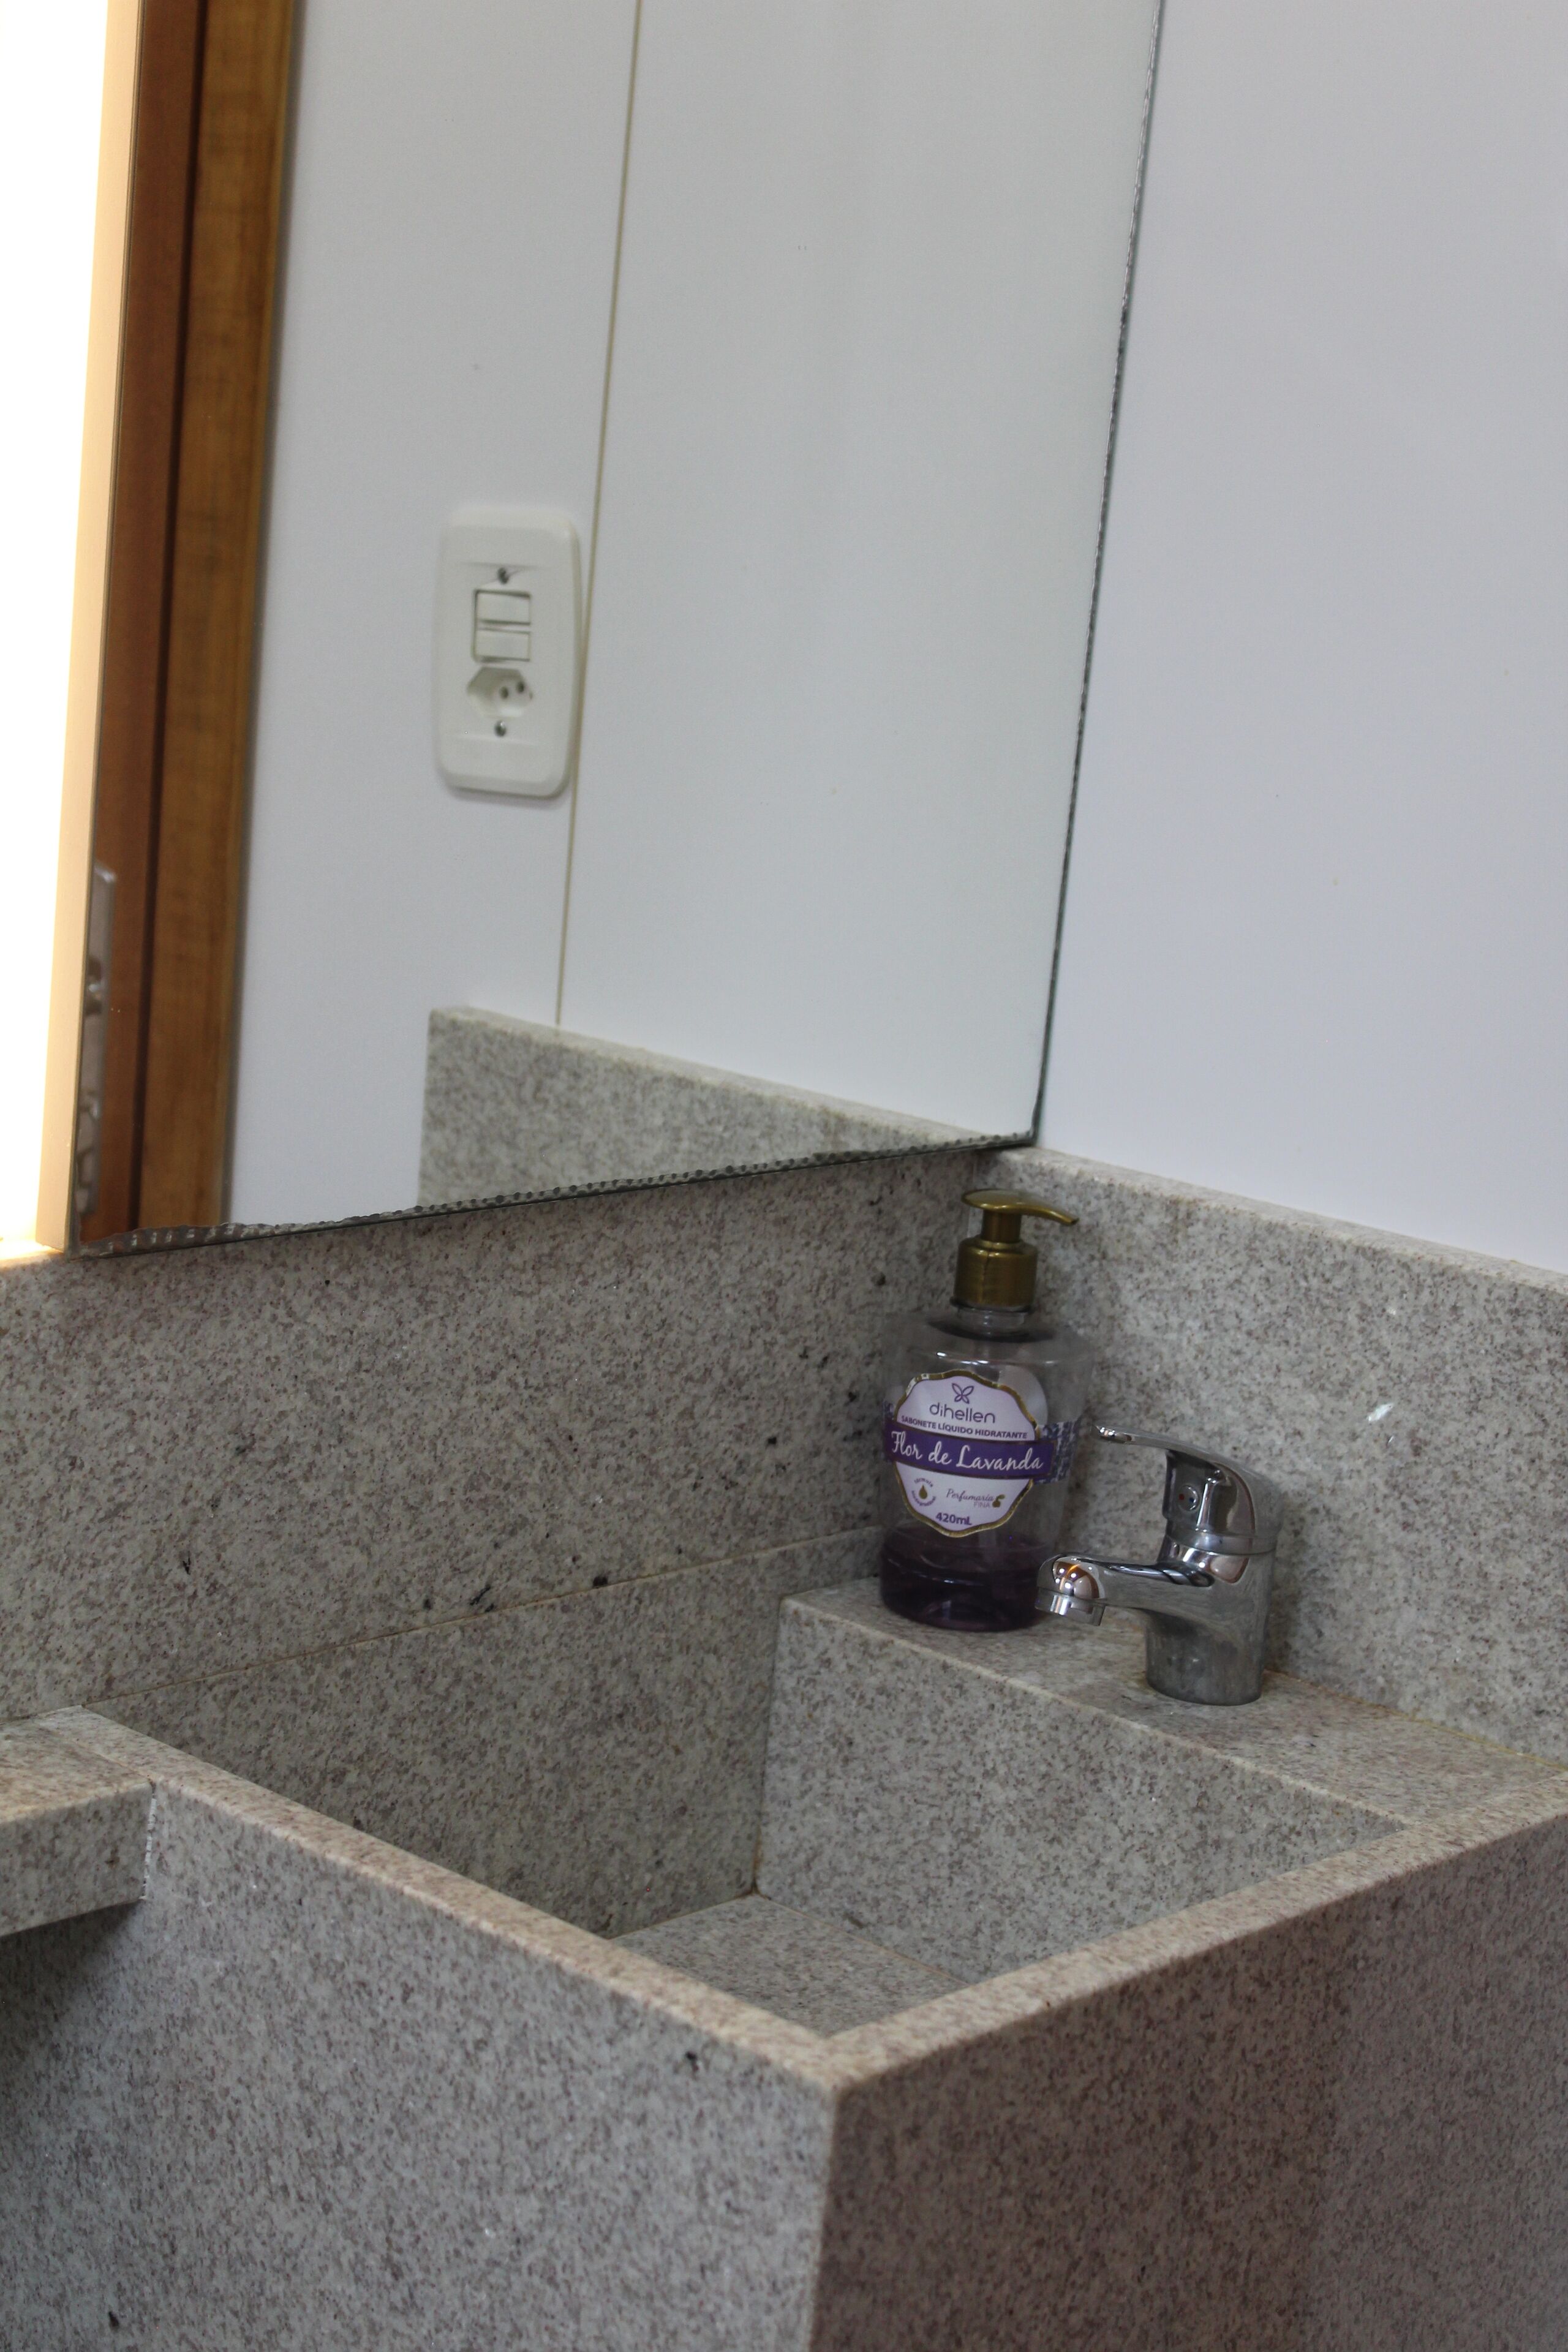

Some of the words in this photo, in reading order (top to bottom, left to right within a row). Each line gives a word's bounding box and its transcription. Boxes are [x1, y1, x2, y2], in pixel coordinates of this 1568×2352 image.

[929, 1402, 996, 1423] dihellen
[901, 1415, 937, 1429] SABONETE
[938, 1423, 973, 1434] LÍQUIDO
[975, 1430, 1028, 1439] HIDRATANTE
[891, 1431, 922, 1460] Flor
[928, 1441, 952, 1464] de
[956, 1445, 1044, 1471] Lavanda
[936, 1512, 972, 1525] 420mL
